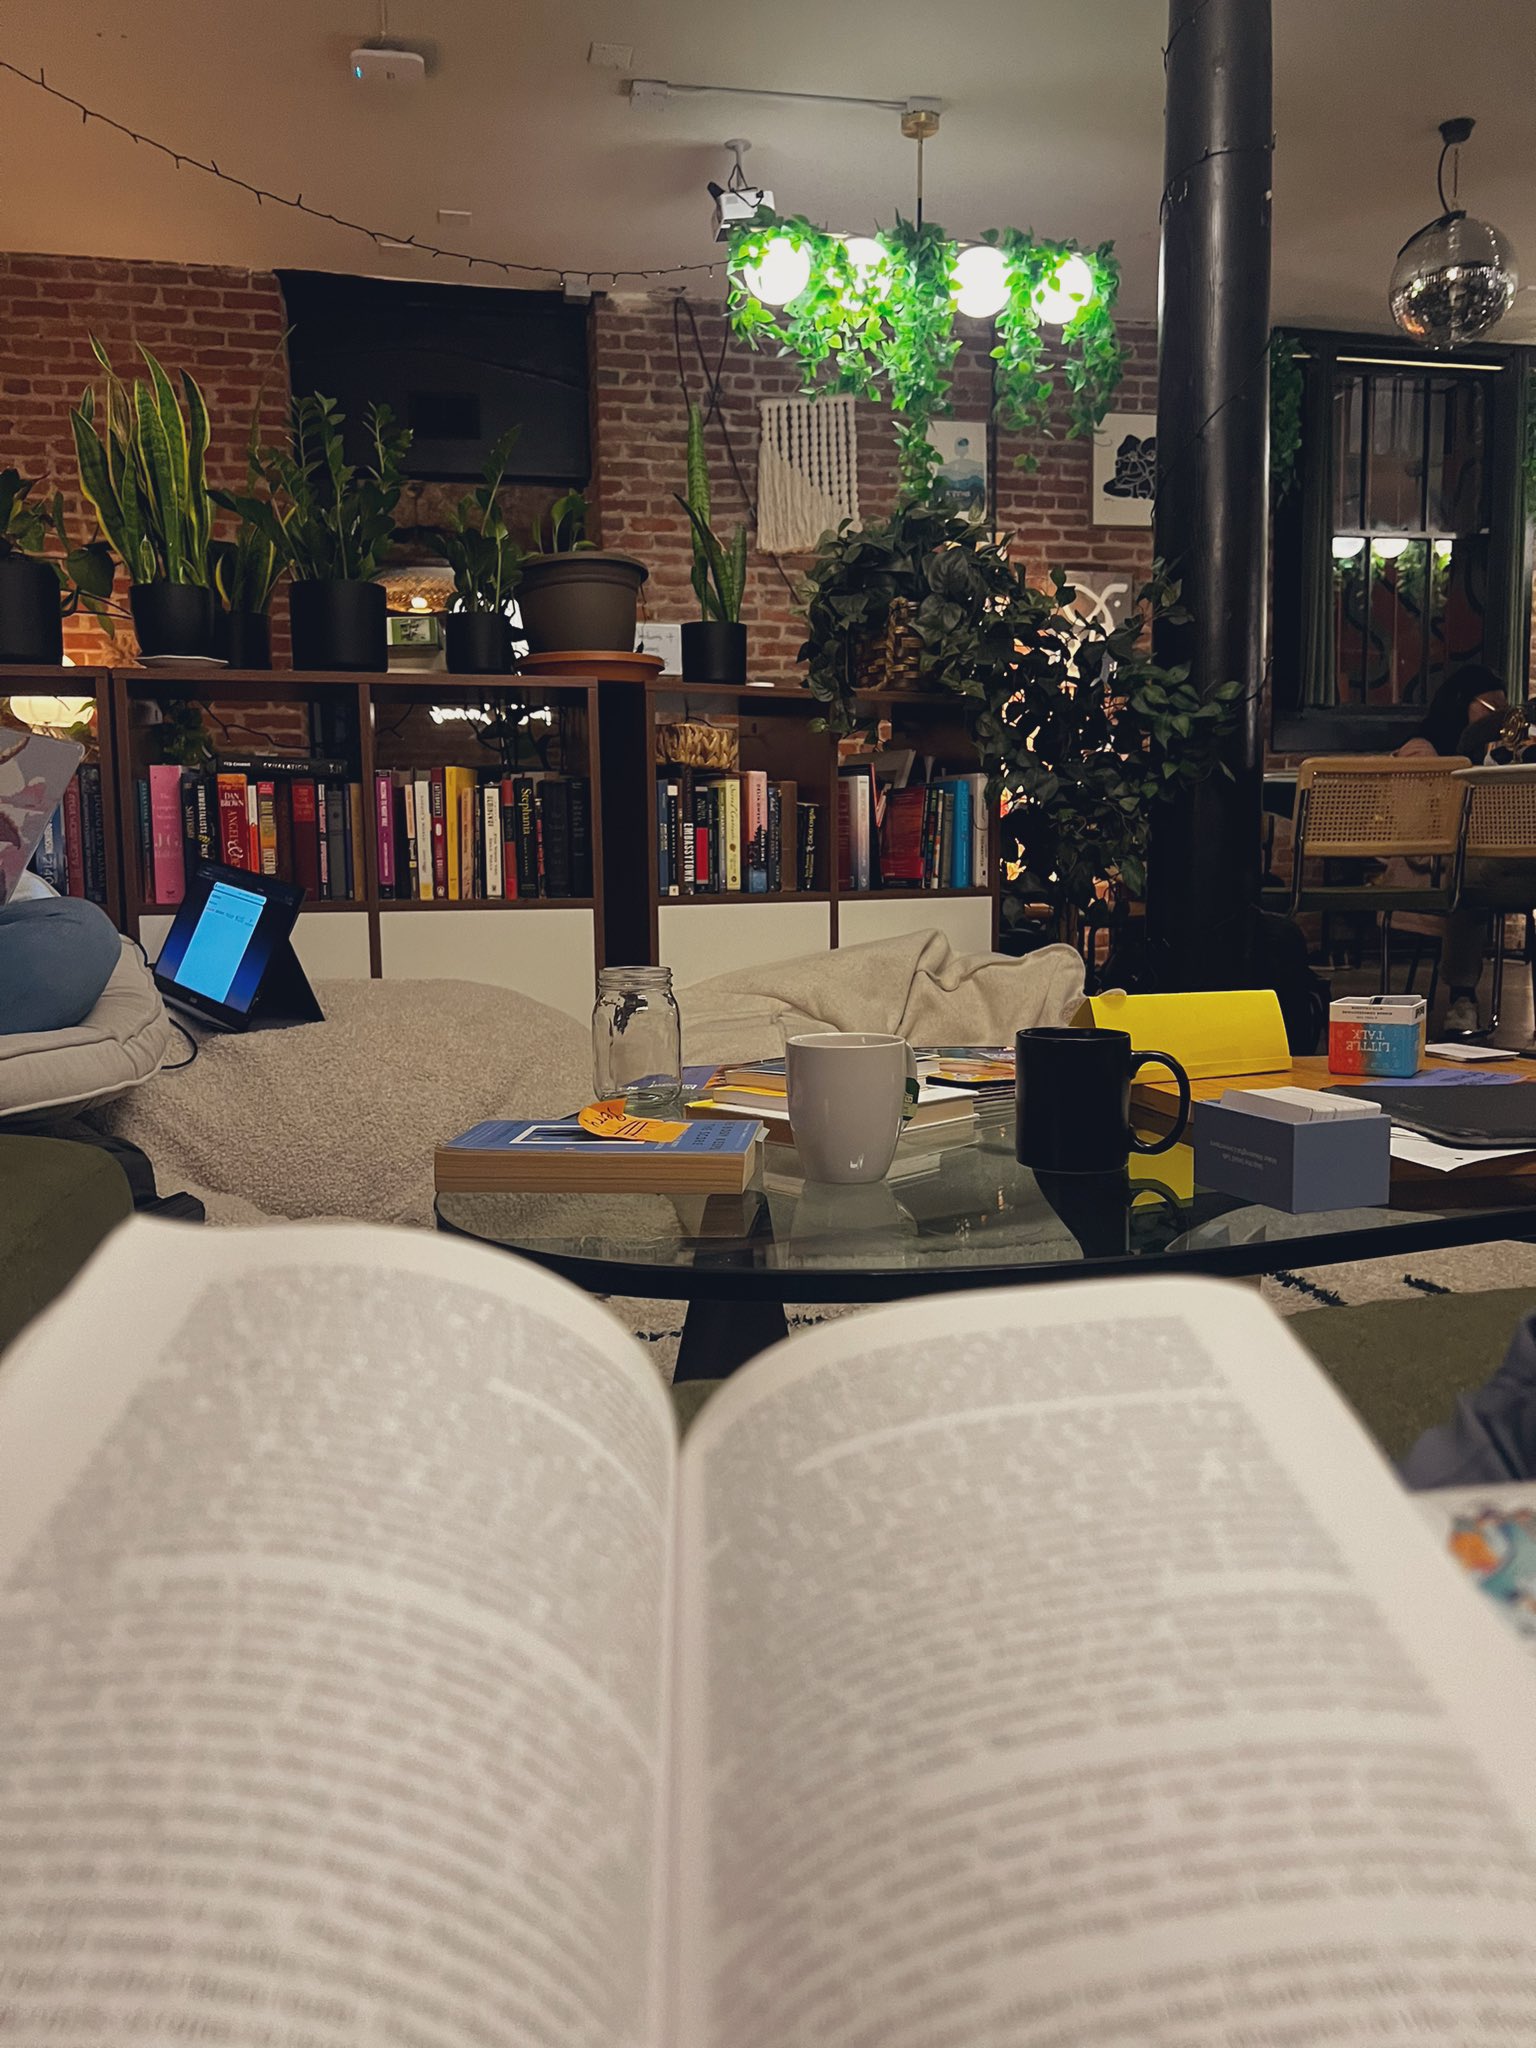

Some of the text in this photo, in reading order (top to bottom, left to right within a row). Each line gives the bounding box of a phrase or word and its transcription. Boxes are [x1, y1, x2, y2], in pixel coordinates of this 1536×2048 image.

[263, 762, 309, 772] EXHALATION
[224, 792, 238, 800] DAN
[219, 799, 244, 808] BROWN
[517, 787, 533, 836] Stephania
[94, 794, 107, 888] DOUGLAS ADAMS
[683, 822, 695, 882] EMBASSYTOWN
[1352, 1029, 1386, 1041] TALK
[1346, 1041, 1391, 1053] LITTLE
